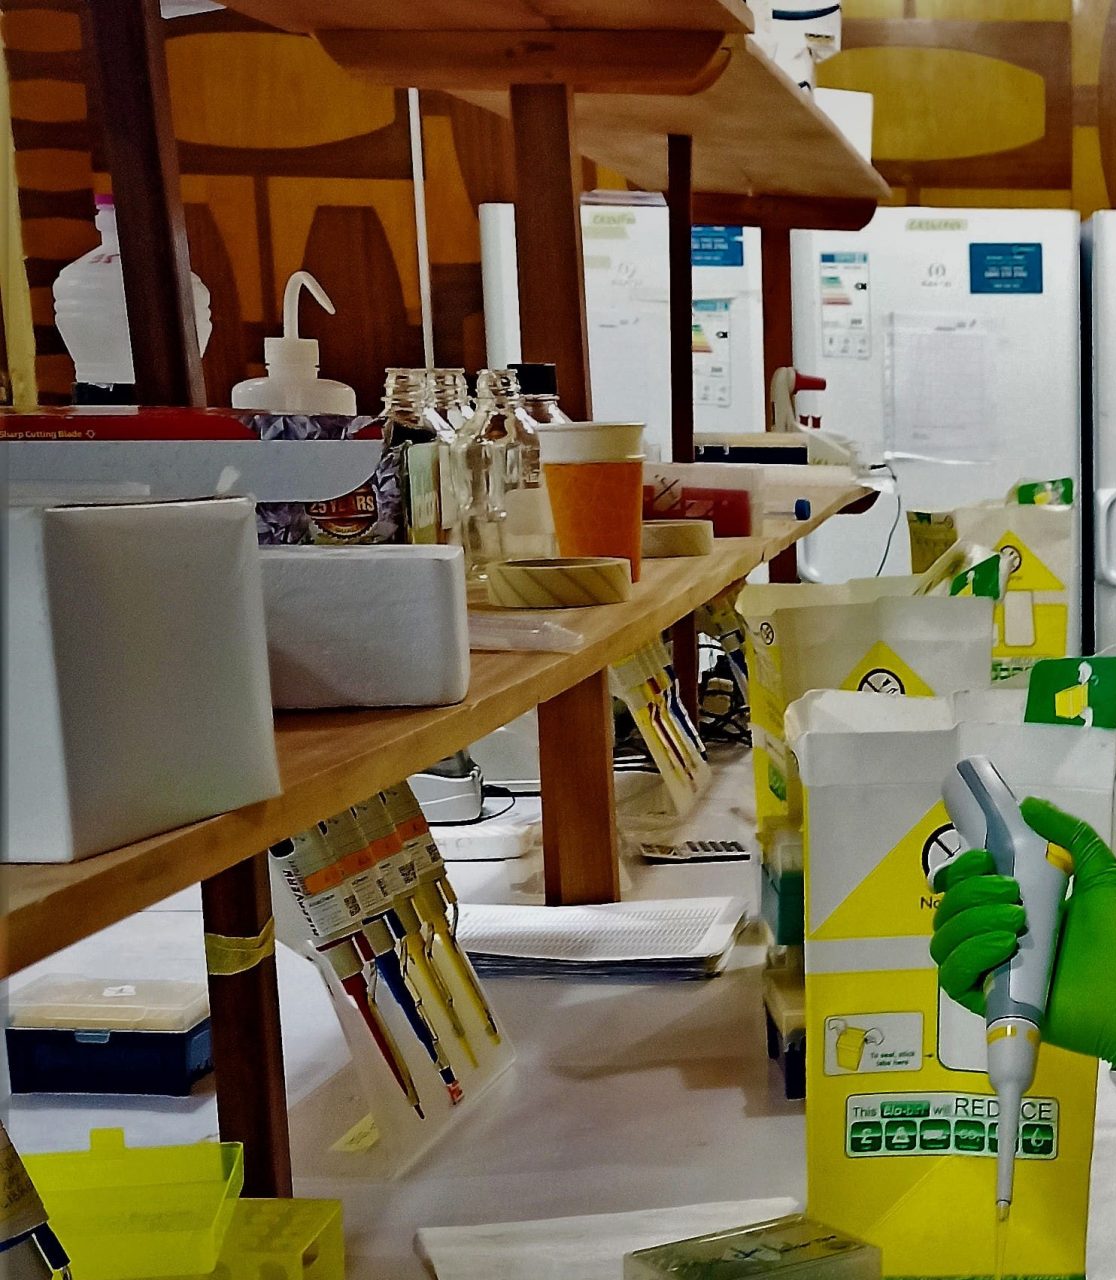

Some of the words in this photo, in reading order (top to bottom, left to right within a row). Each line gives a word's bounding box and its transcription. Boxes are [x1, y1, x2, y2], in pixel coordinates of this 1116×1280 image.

[25, 430, 57, 440] Cutting
[58, 430, 82, 438] Blade
[853, 1106, 877, 1118] This
[954, 1097, 1053, 1121] REDCE
